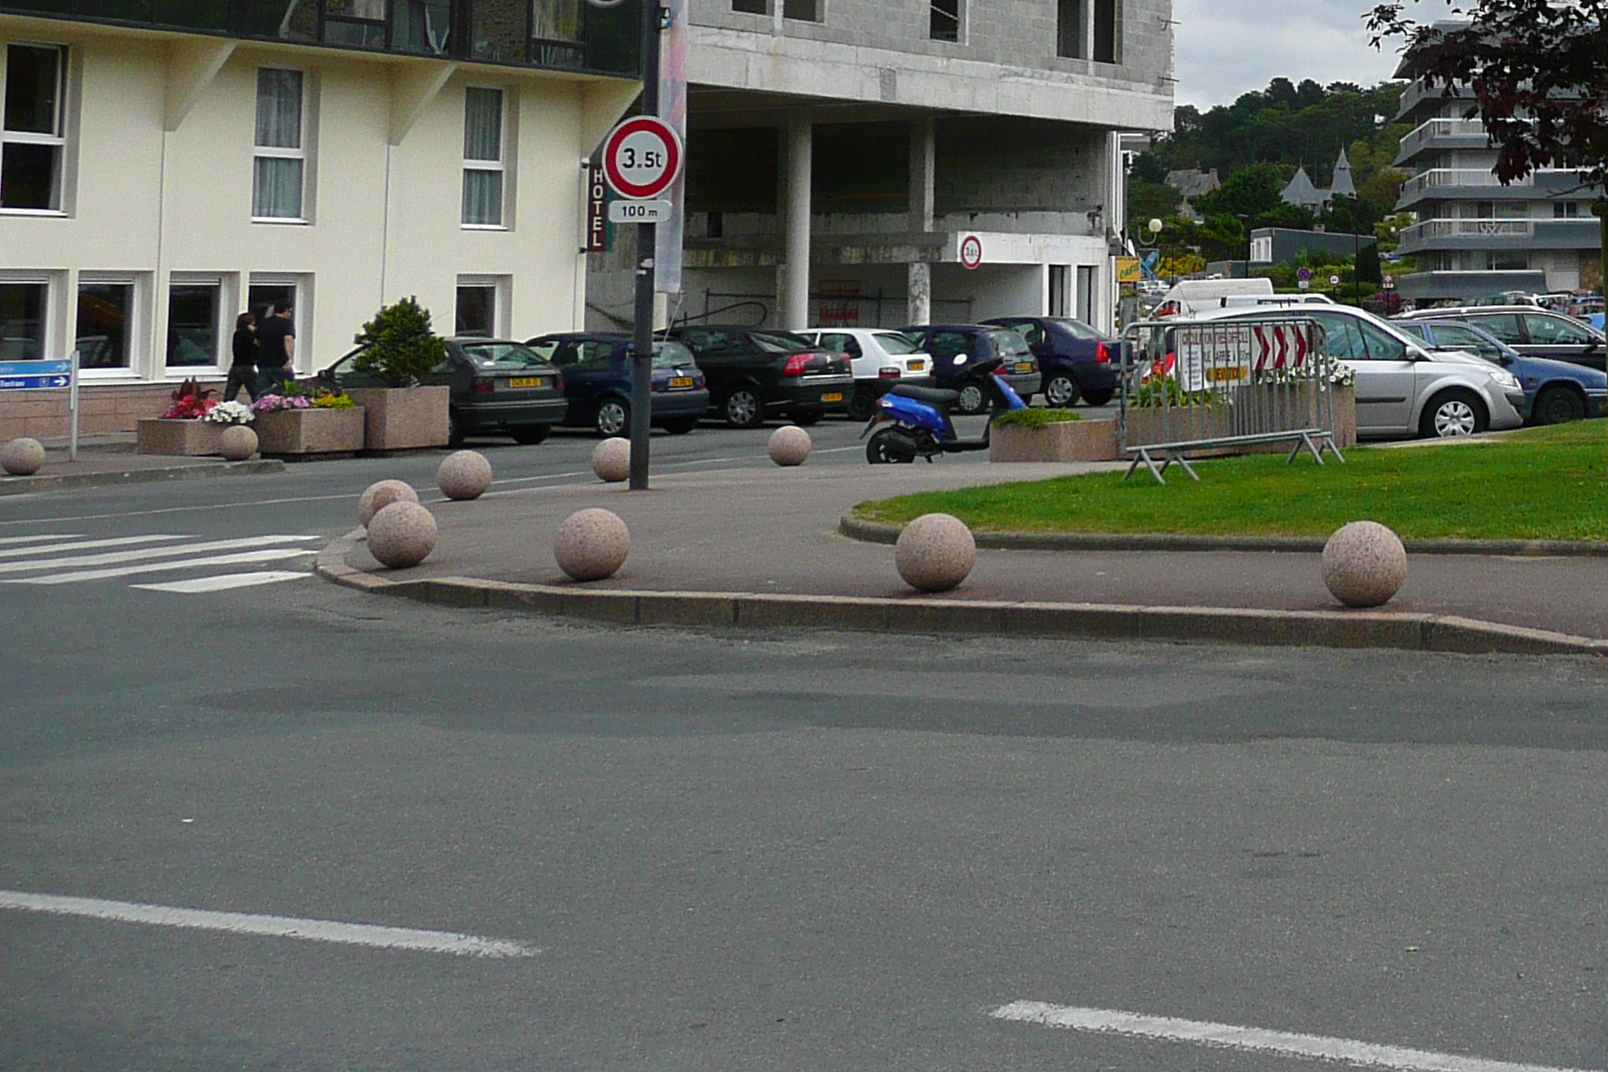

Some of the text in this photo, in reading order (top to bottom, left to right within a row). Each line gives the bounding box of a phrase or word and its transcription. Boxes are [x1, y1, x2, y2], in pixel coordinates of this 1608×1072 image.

[622, 147, 662, 169] 3.5t
[592, 168, 604, 247] HOTEL
[621, 205, 658, 217] 100 m
